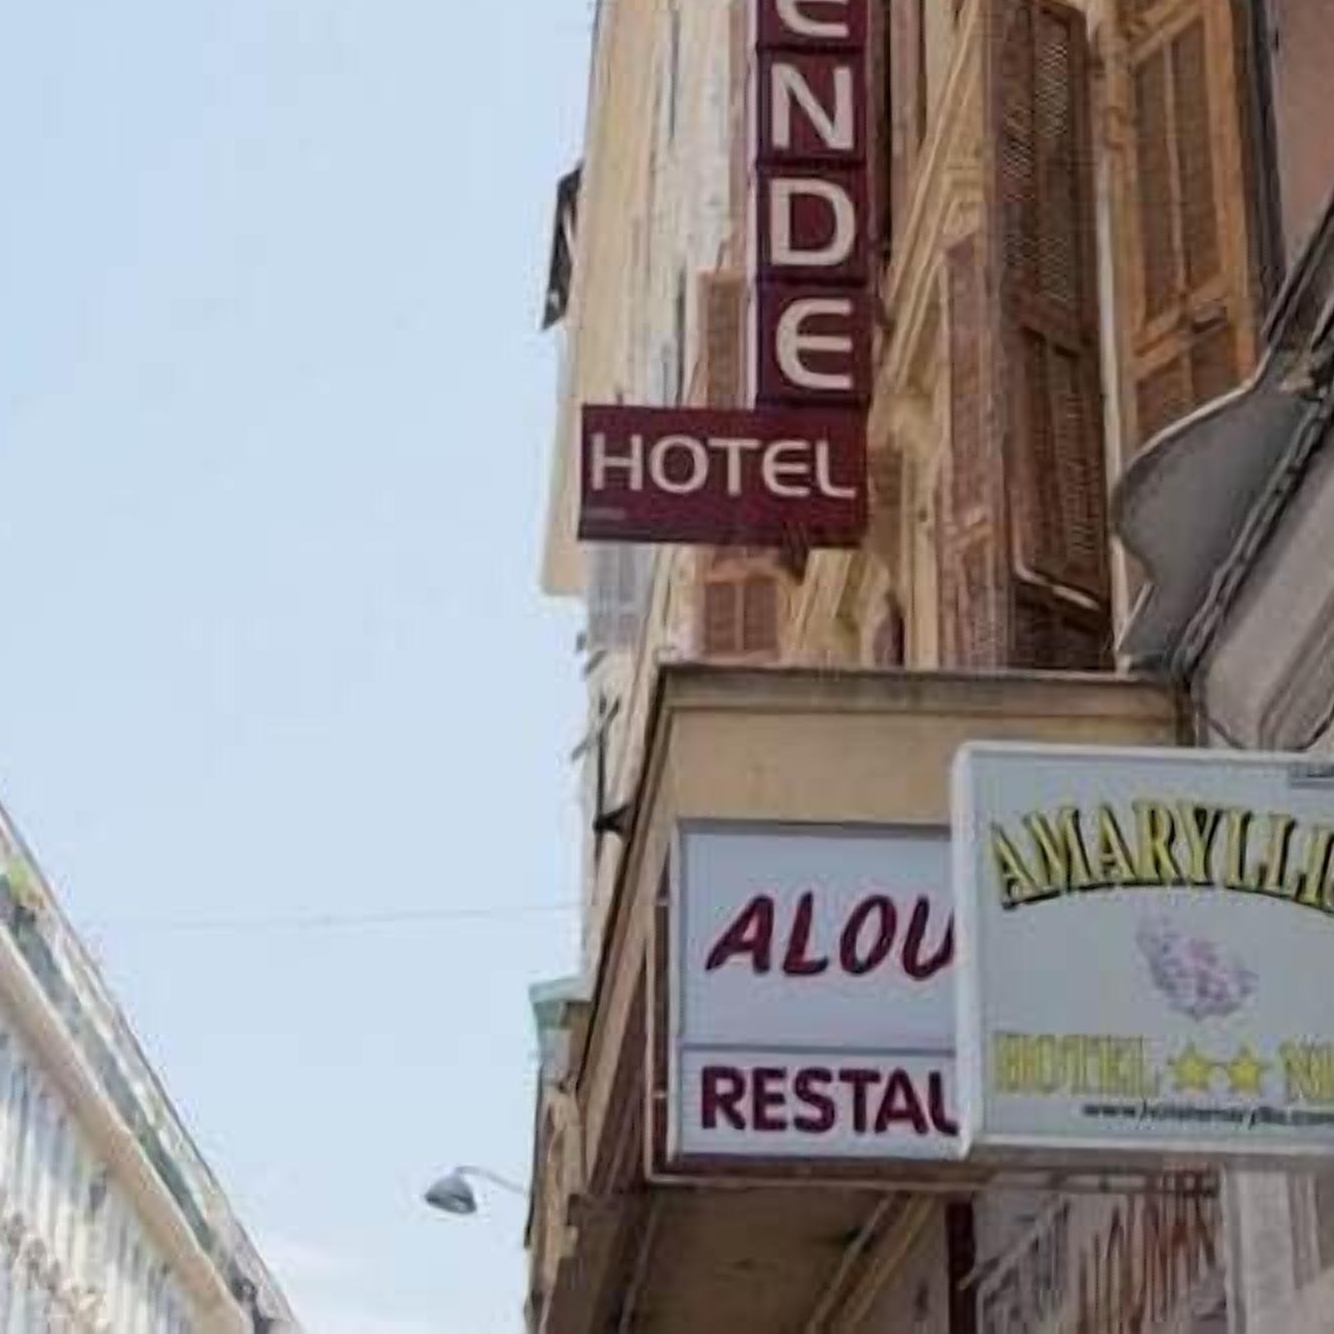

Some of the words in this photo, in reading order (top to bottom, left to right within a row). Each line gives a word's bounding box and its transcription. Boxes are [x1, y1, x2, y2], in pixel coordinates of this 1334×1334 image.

[591, 431, 857, 499] HOTEL
[704, 889, 955, 982] ALOU
[993, 1031, 1161, 1098] HOTEL
